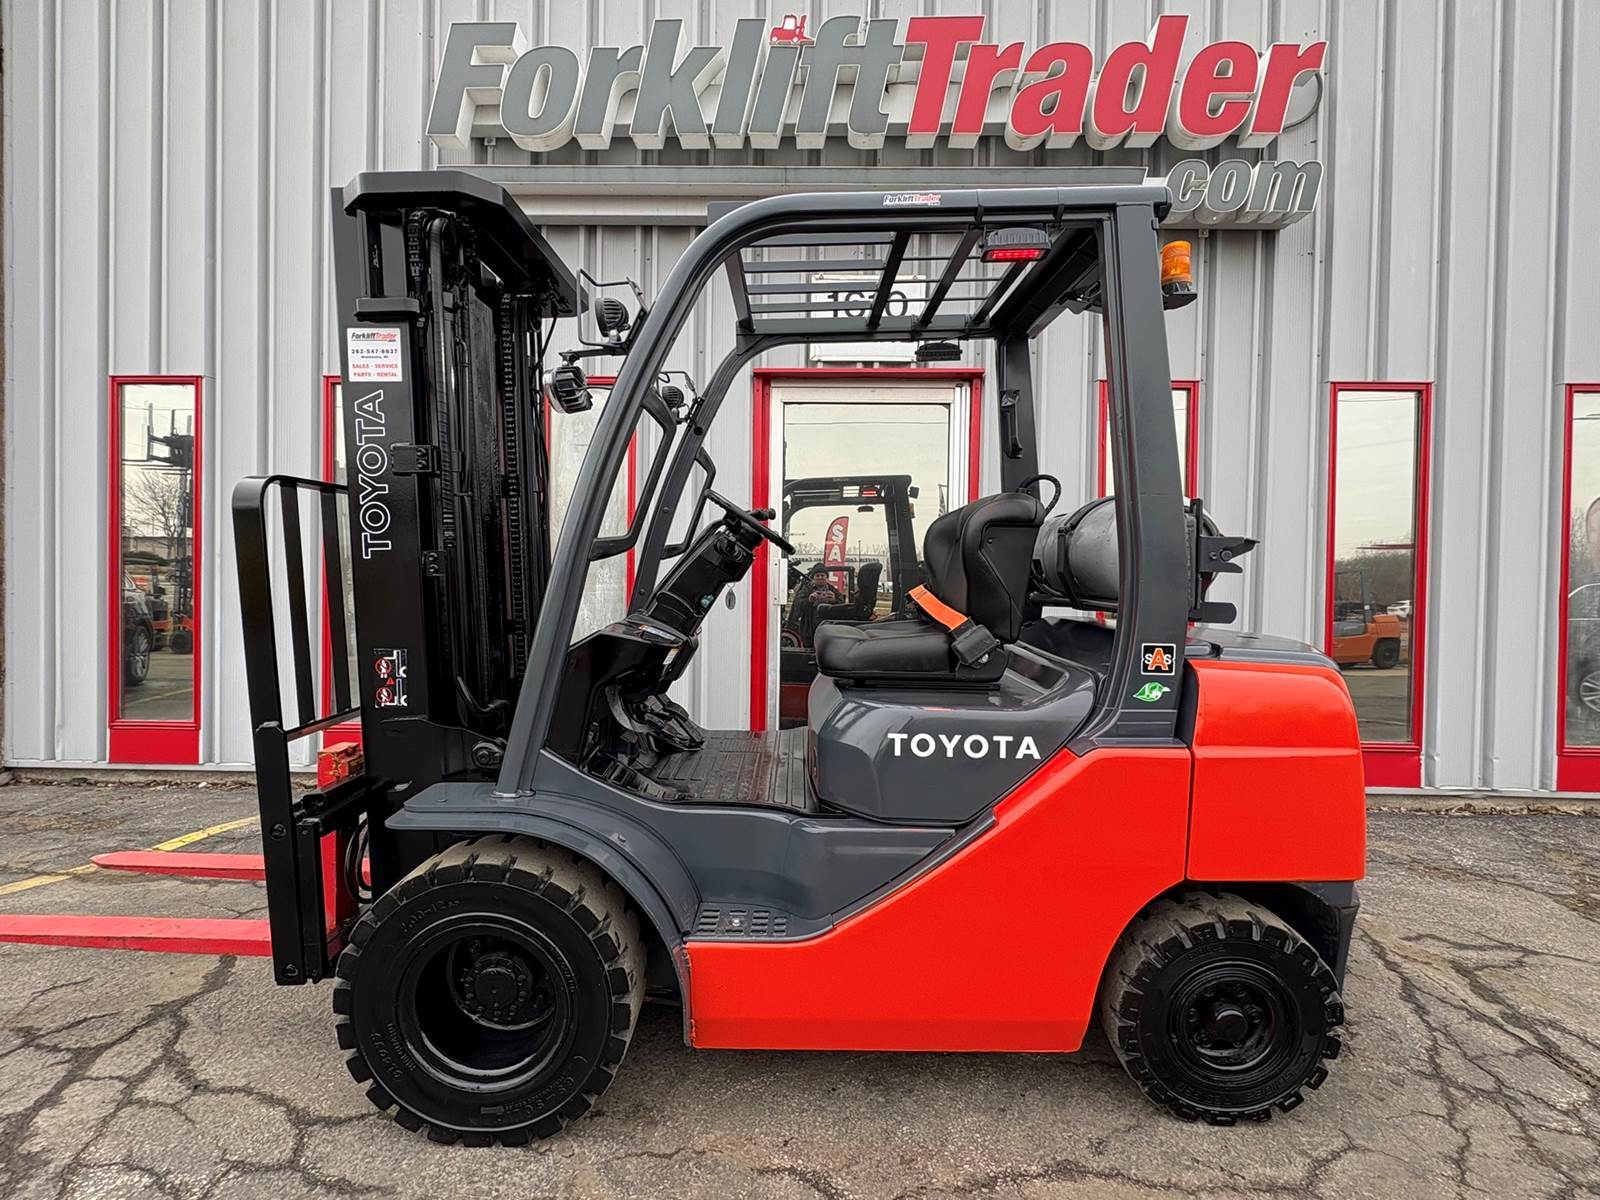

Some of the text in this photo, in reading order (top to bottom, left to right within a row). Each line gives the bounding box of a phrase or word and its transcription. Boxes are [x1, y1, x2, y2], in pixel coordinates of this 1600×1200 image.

[424, 14, 1329, 137] ForkliftTrader
[827, 289, 909, 318] 160
[354, 389, 393, 560] TOYOTA
[828, 524, 844, 590] SAL
[1144, 647, 1173, 671] SAS
[887, 732, 1042, 760] TOYOTA
